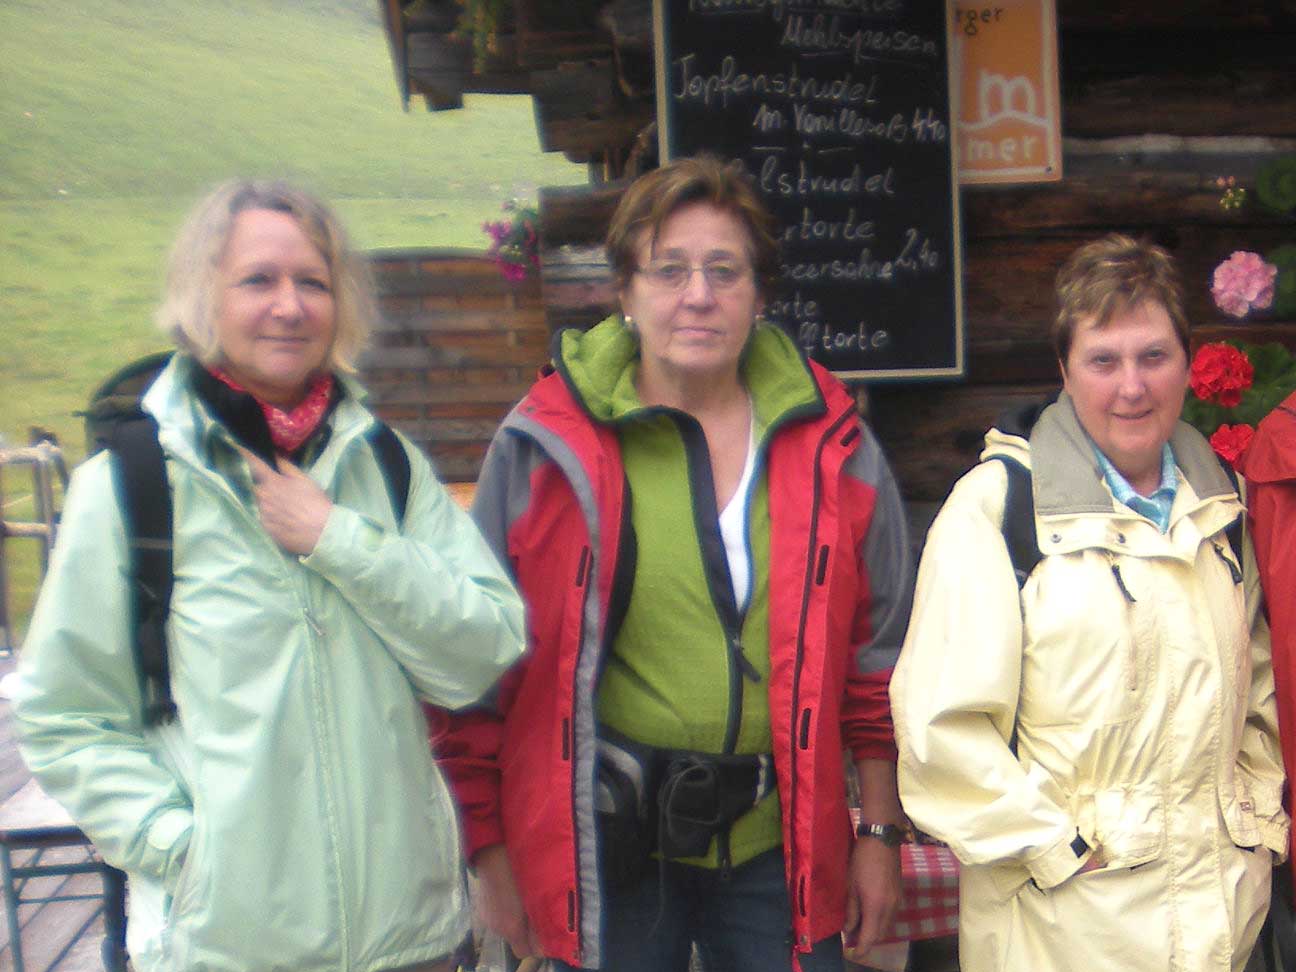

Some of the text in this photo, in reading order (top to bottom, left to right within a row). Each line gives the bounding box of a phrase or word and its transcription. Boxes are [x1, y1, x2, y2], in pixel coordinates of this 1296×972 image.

[955, 8, 1007, 36] rger
[673, 53, 880, 108] Topfenstrudel
[967, 136, 1038, 162] mer
[752, 155, 897, 198] lstrudel
[778, 207, 876, 242] rtorte
[780, 248, 894, 281] eersahne
[798, 320, 889, 352] fftorte
